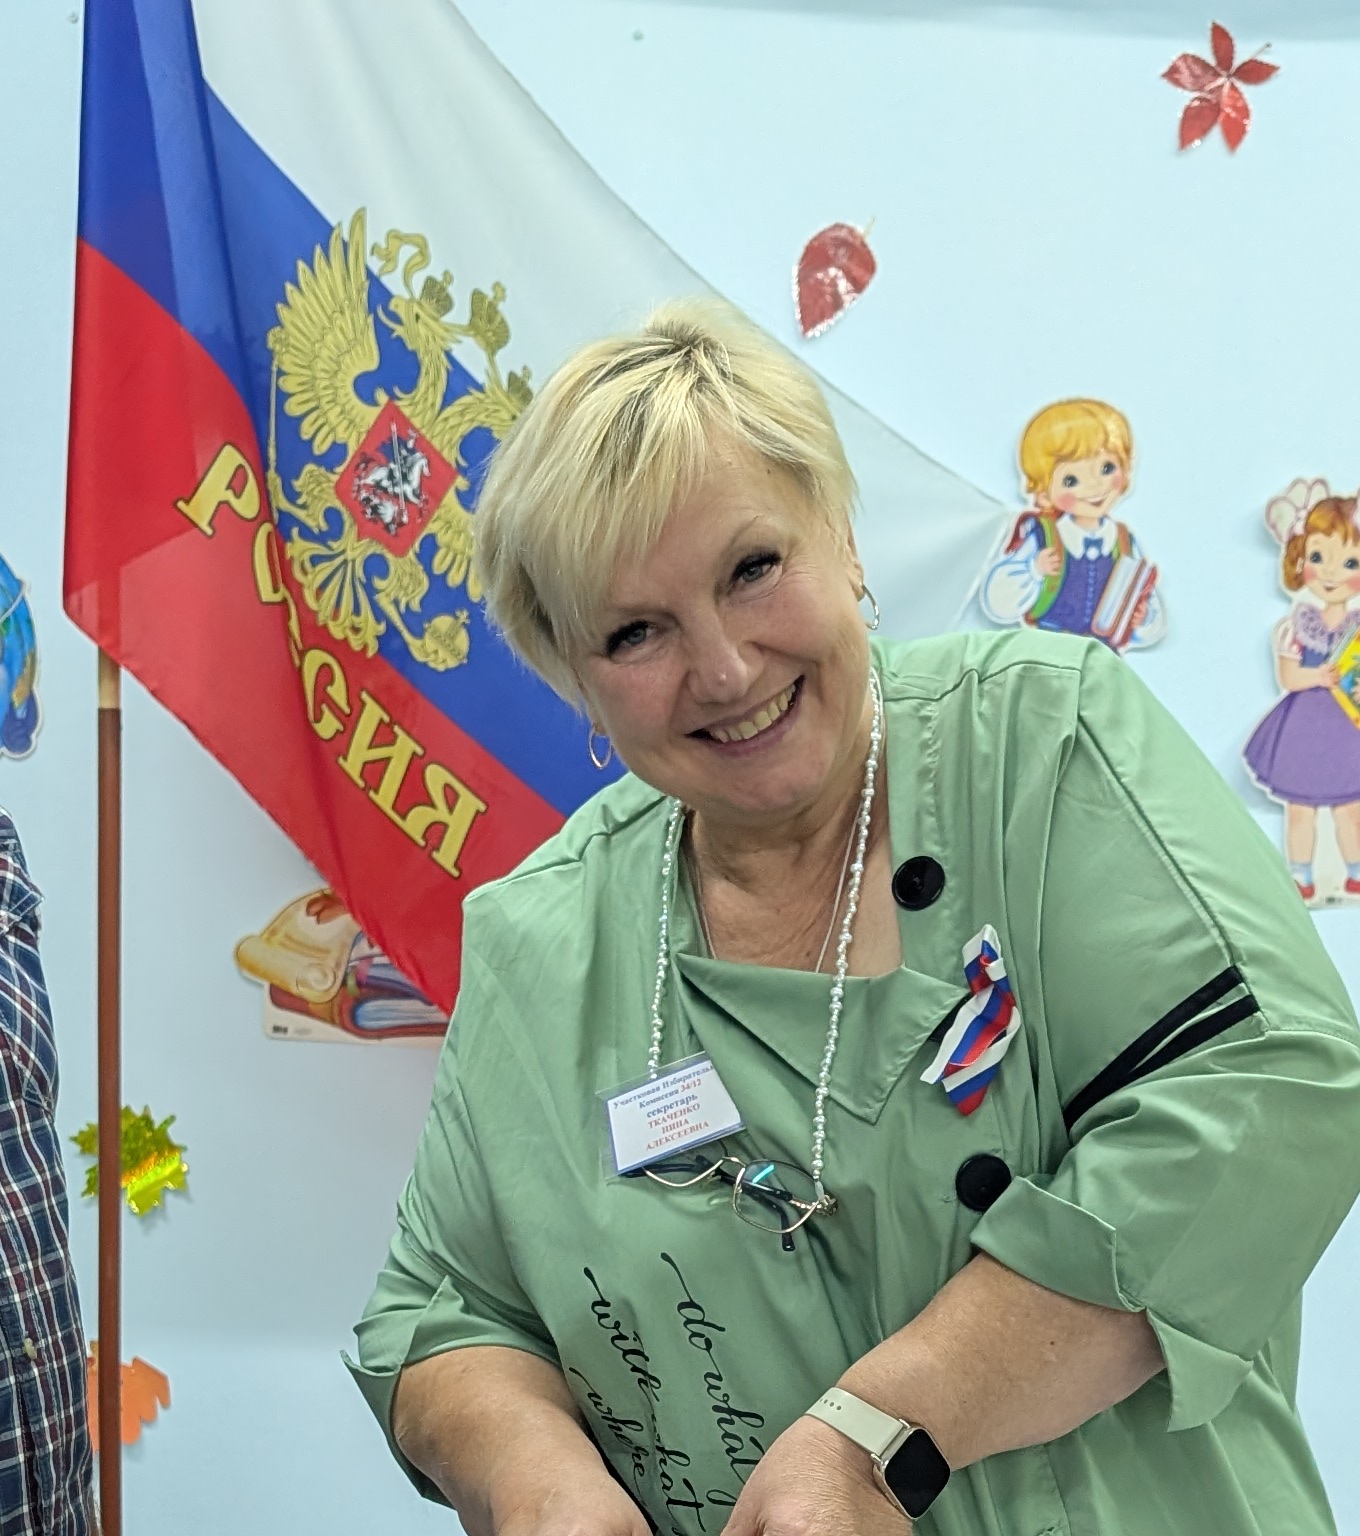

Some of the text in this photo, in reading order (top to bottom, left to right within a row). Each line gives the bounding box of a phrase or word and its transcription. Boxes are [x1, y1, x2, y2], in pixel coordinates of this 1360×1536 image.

[613, 1086, 660, 1109] Участковая
[681, 1079, 701, 1092] 34/12
[646, 1093, 698, 1118] секретарь
[648, 1103, 701, 1128] ТКАЧЕНКО
[646, 1121, 709, 1151] АЛЕКСЕЕВНА
